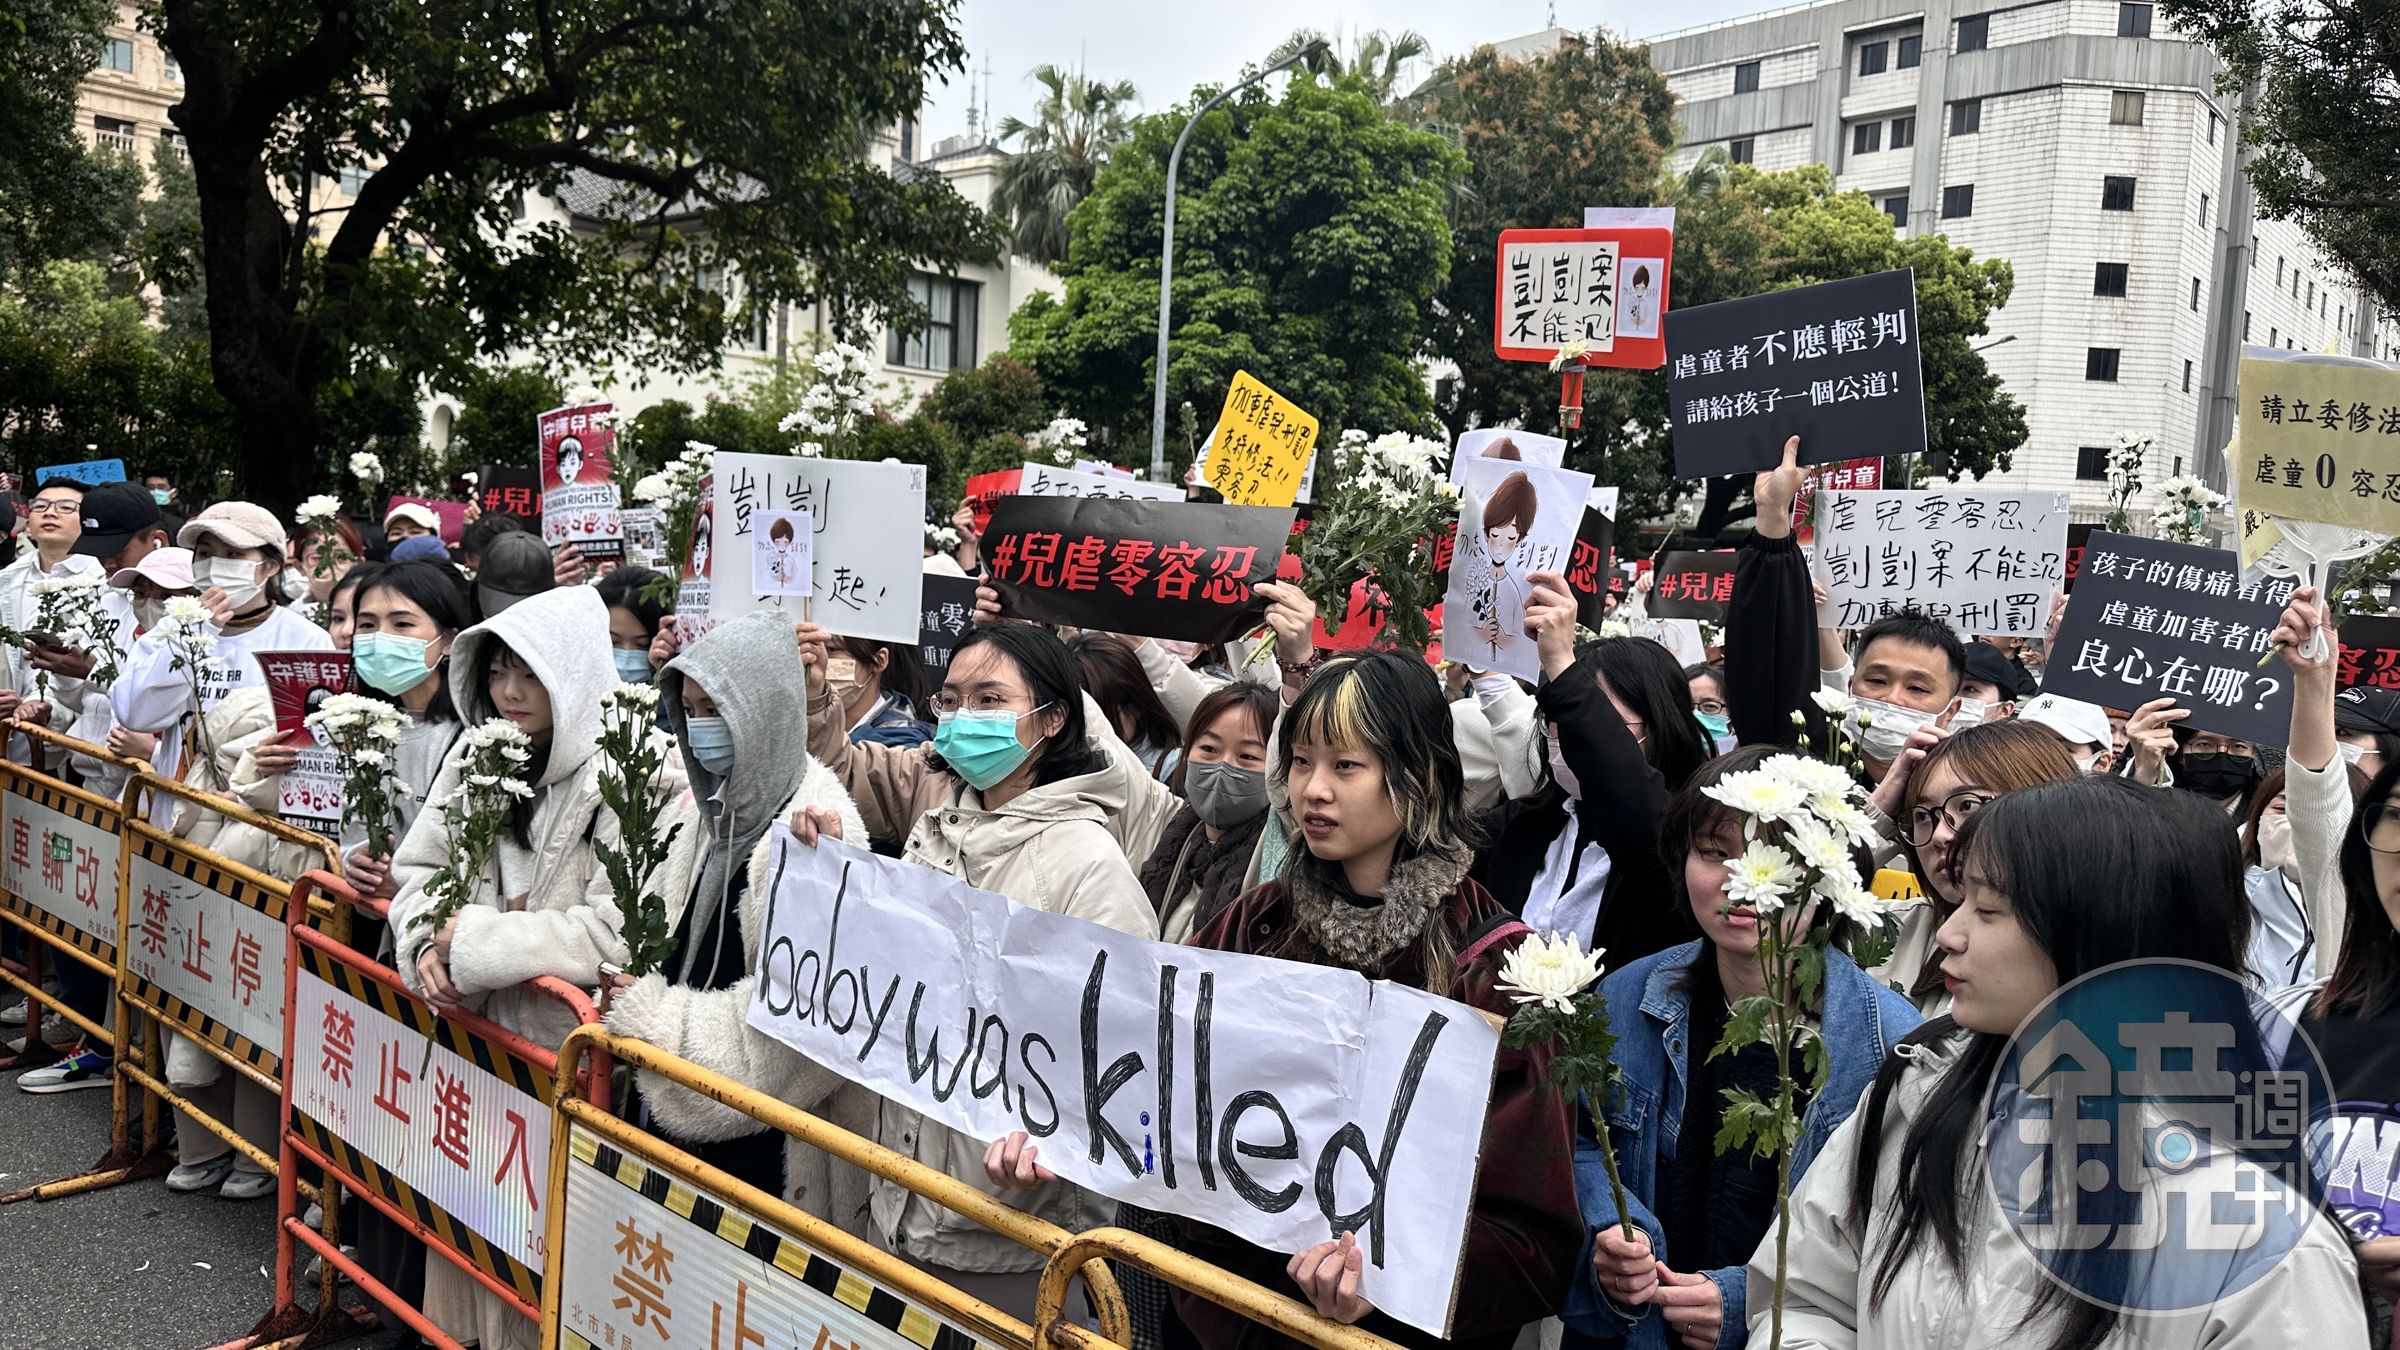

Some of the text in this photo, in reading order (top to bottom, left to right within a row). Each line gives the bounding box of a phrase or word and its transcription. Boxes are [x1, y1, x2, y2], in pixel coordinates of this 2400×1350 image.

[1512, 248, 1613, 308] 剴剴案
[1674, 309, 1907, 379] 虐童者不應輕判
[1686, 371, 1899, 424] 請給孩子一個公道!
[2260, 394, 2400, 435] 請立委修法
[1829, 493, 2045, 533] 虐兒零容忍!
[992, 531, 1258, 604] #兒虐零容忍
[1568, 539, 1601, 594] 忍
[678, 592, 710, 606] UMAN RIG
[920, 602, 977, 637] 童零
[2098, 599, 2276, 654] 虐童加害者的
[2071, 637, 2281, 711] 良心在哪?
[293, 760, 320, 773] UMAN
[141, 885, 285, 1008] 禁止停
[759, 837, 1449, 1270] baby was killed
[322, 1000, 538, 1211] 禁止進入
